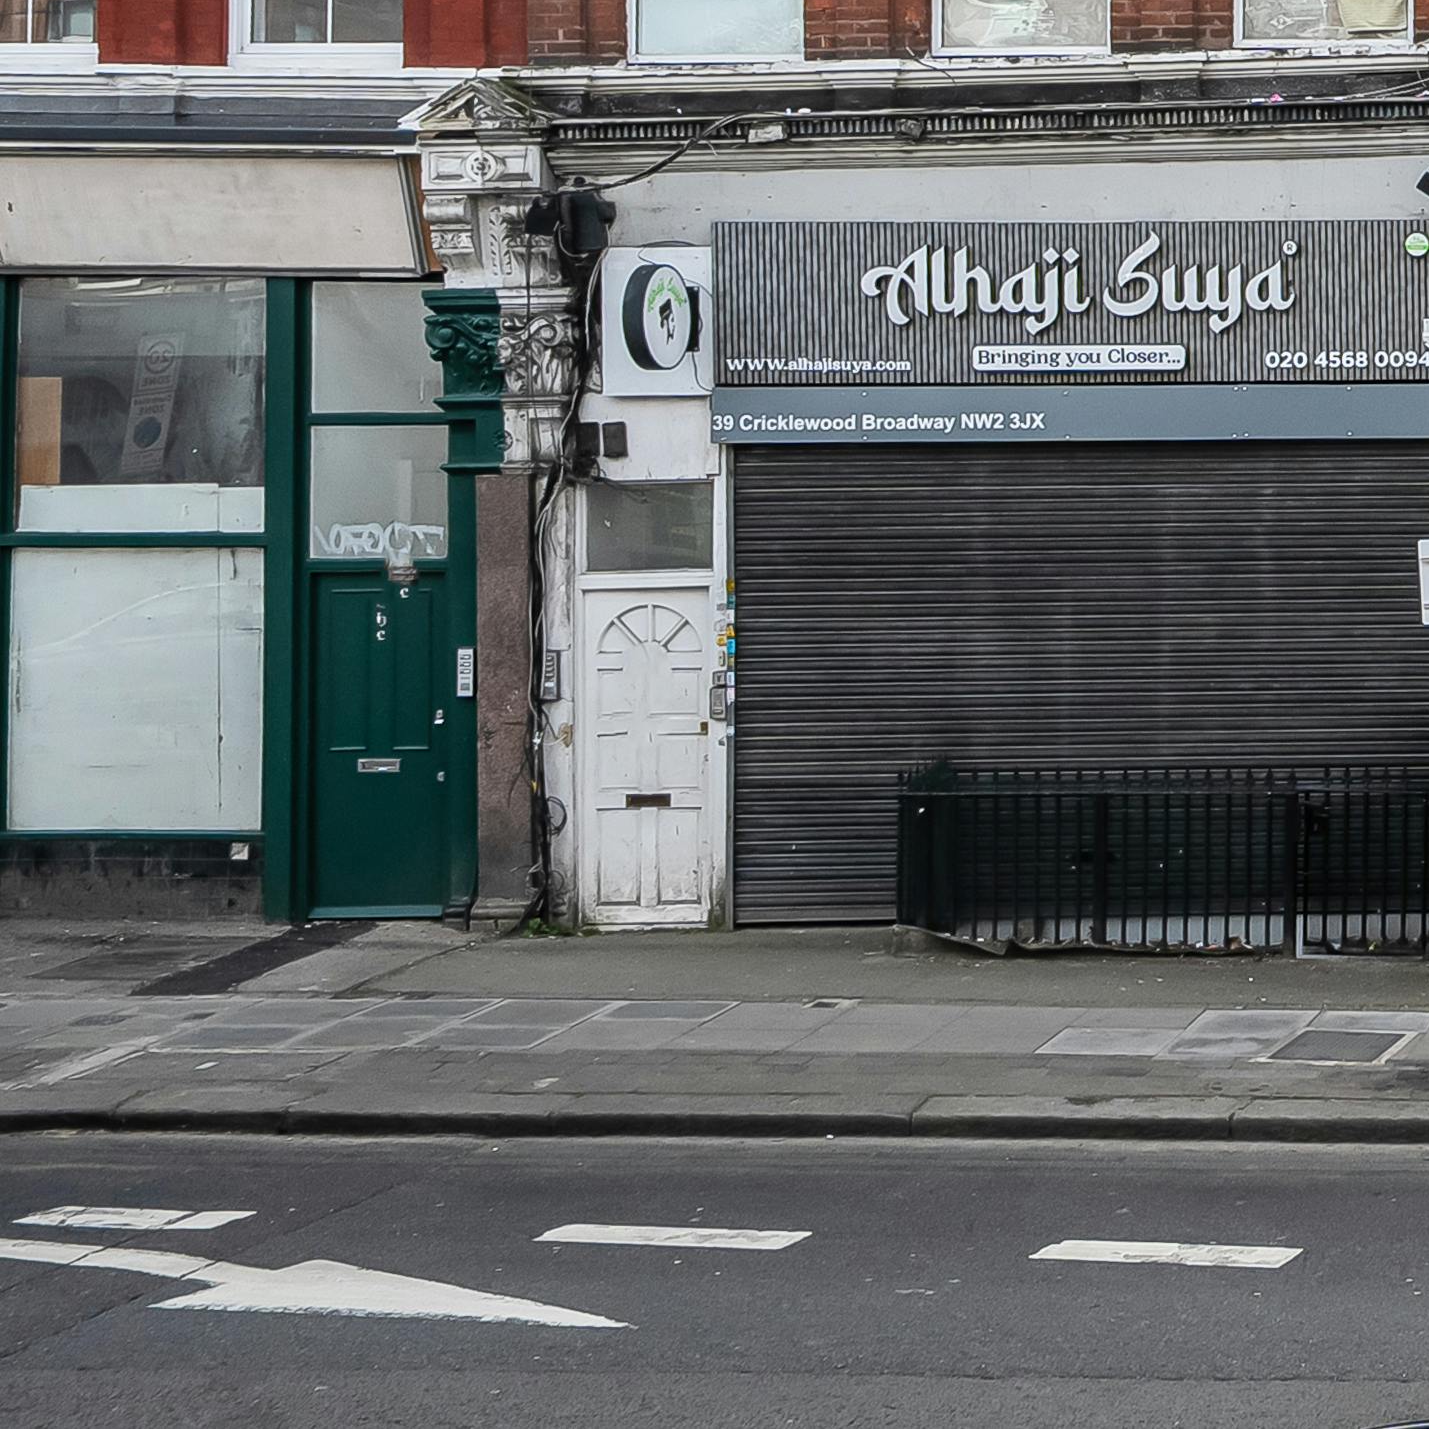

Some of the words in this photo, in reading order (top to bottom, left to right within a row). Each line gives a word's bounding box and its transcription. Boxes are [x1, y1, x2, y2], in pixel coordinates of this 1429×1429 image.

[861, 244, 1091, 336] Alhaji
[1103, 230, 1296, 334] Suya
[978, 350, 1060, 367] Bringing
[1066, 353, 1101, 367] you
[1107, 349, 1181, 364] Closer...
[1265, 352, 1308, 368] 020
[1314, 352, 1368, 368] 4568
[712, 415, 734, 431] 39
[739, 414, 856, 431] Cricklewood
[862, 414, 956, 434] Broadway
[960, 412, 1005, 429] NW2
[1009, 412, 1046, 429] 3JX
